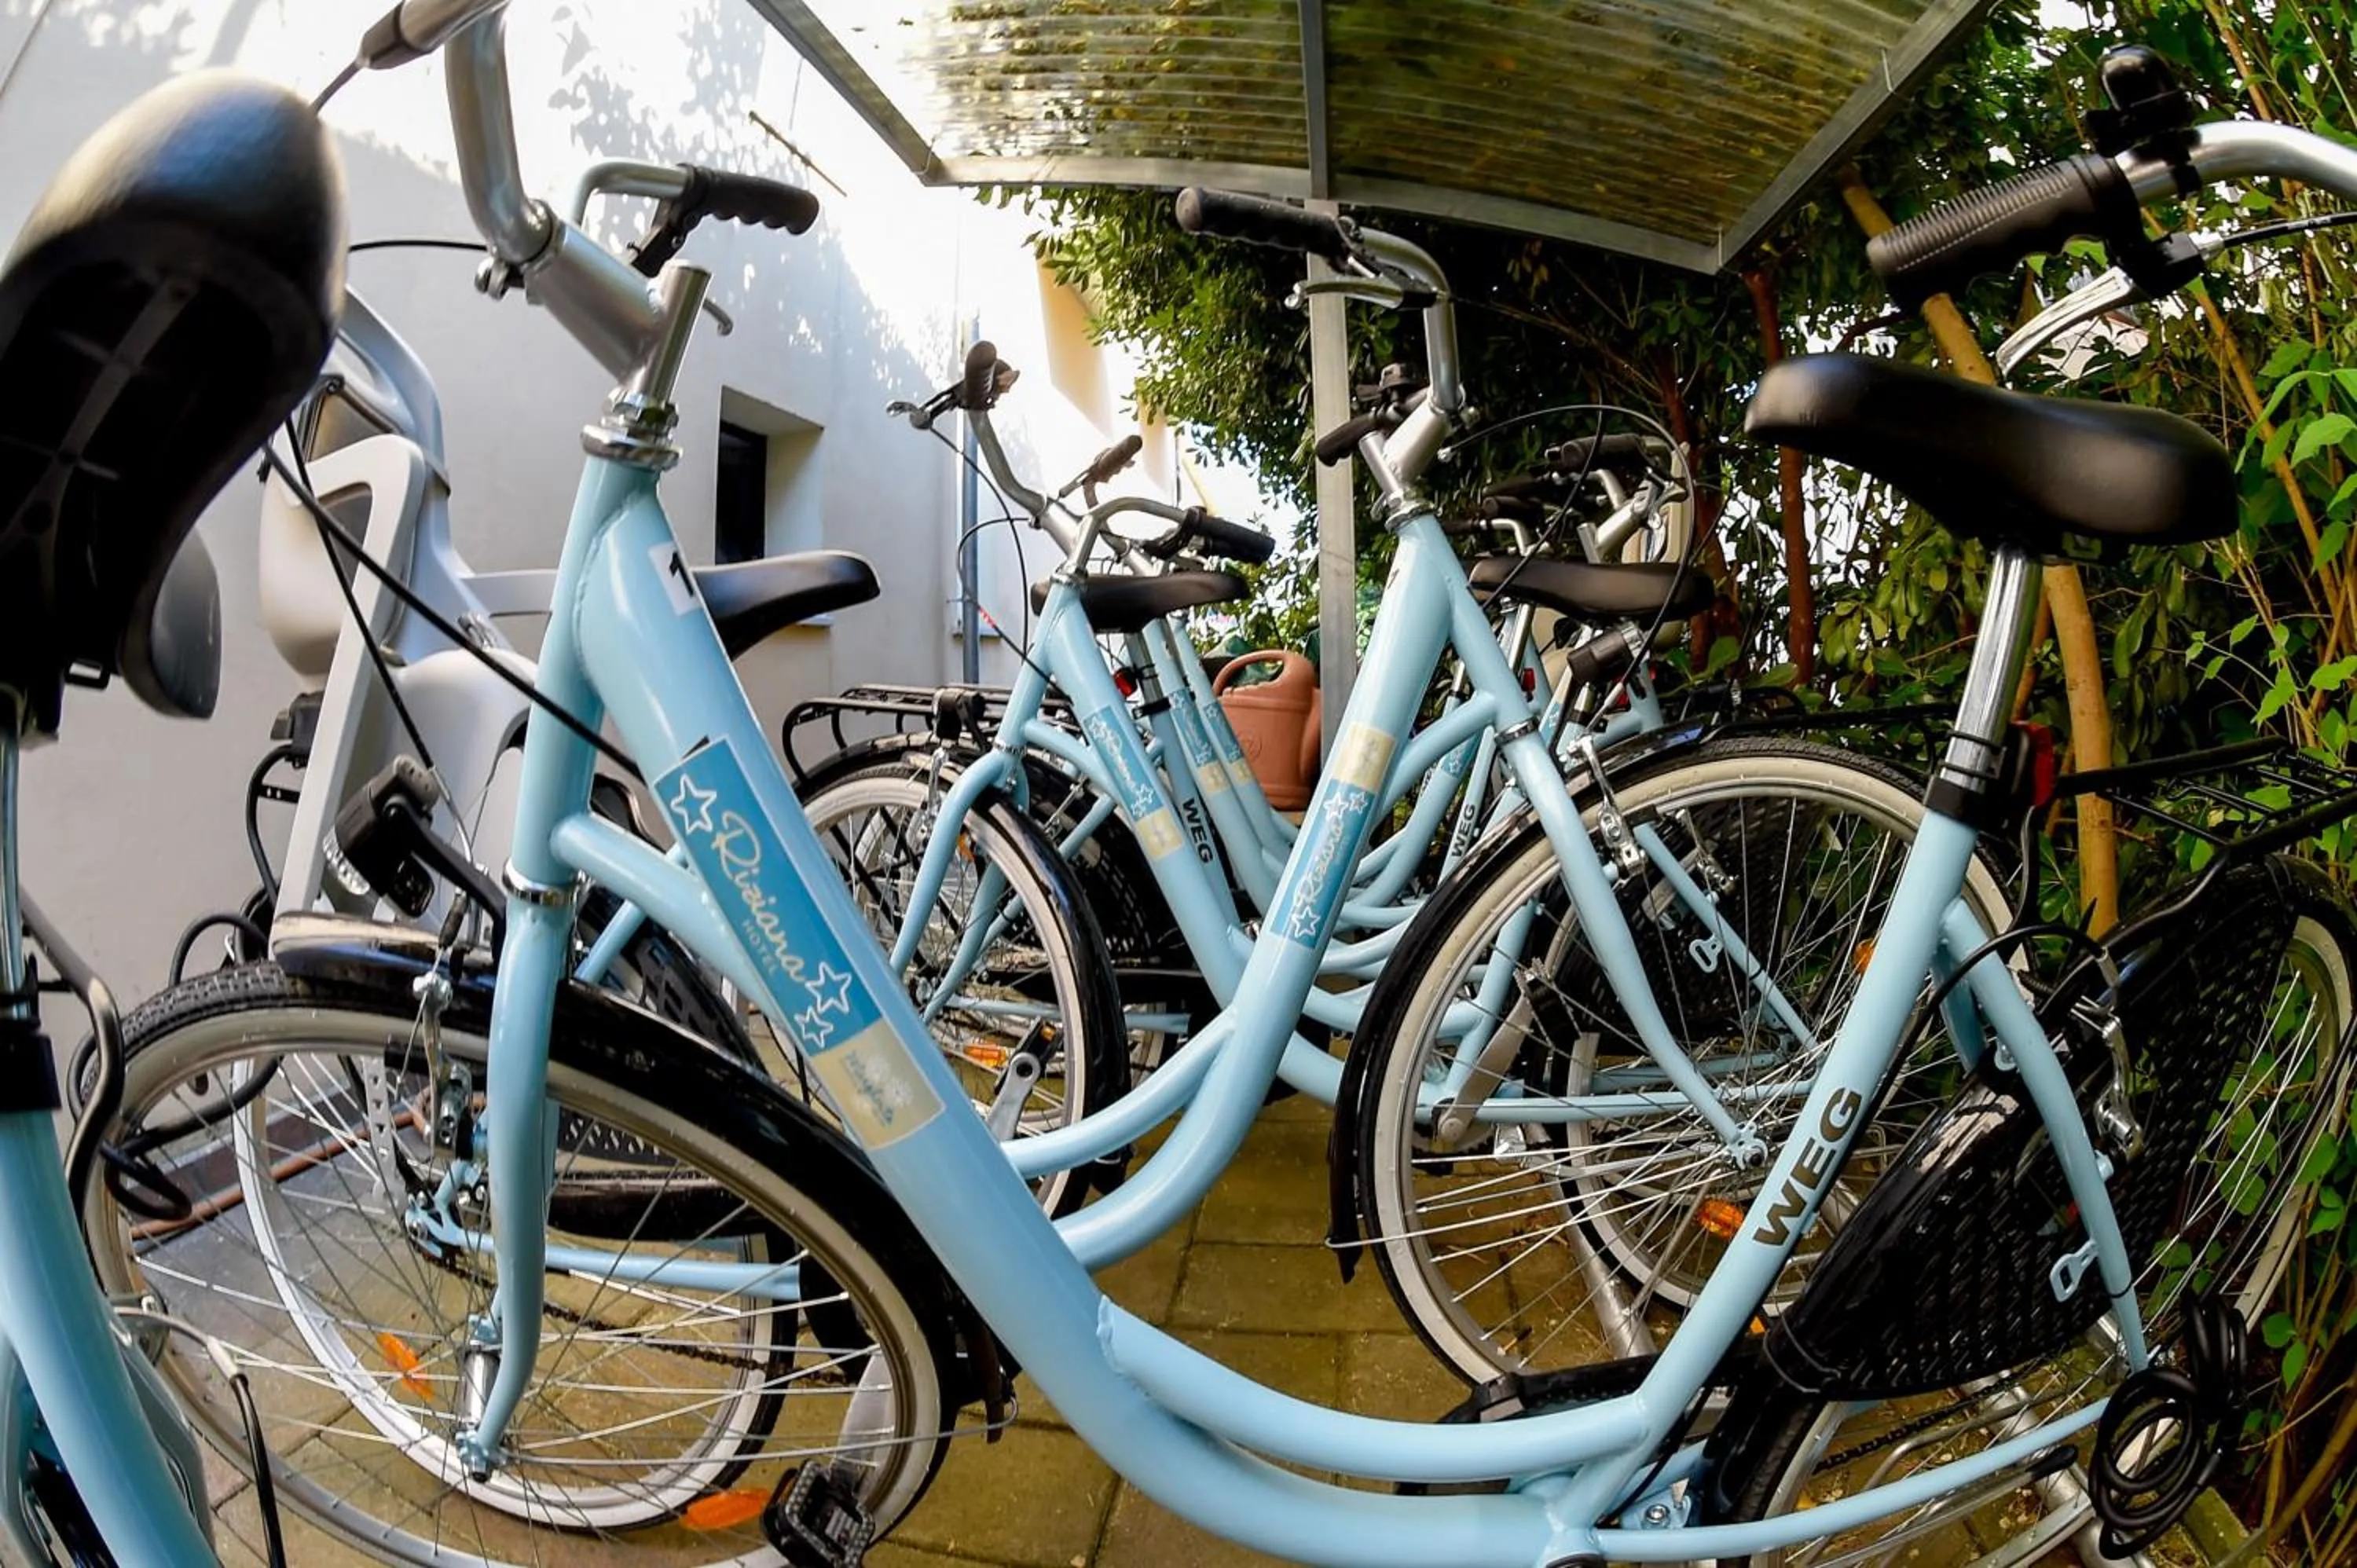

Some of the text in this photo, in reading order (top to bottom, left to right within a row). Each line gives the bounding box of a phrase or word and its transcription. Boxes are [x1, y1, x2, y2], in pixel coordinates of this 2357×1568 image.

[669, 550, 694, 598] 1
[1182, 797, 1214, 864] WEG
[1451, 803, 1475, 858] WEG
[710, 809, 807, 982] Riziana
[742, 918, 779, 977] HOTEL
[1752, 1087, 1862, 1247] WEG
